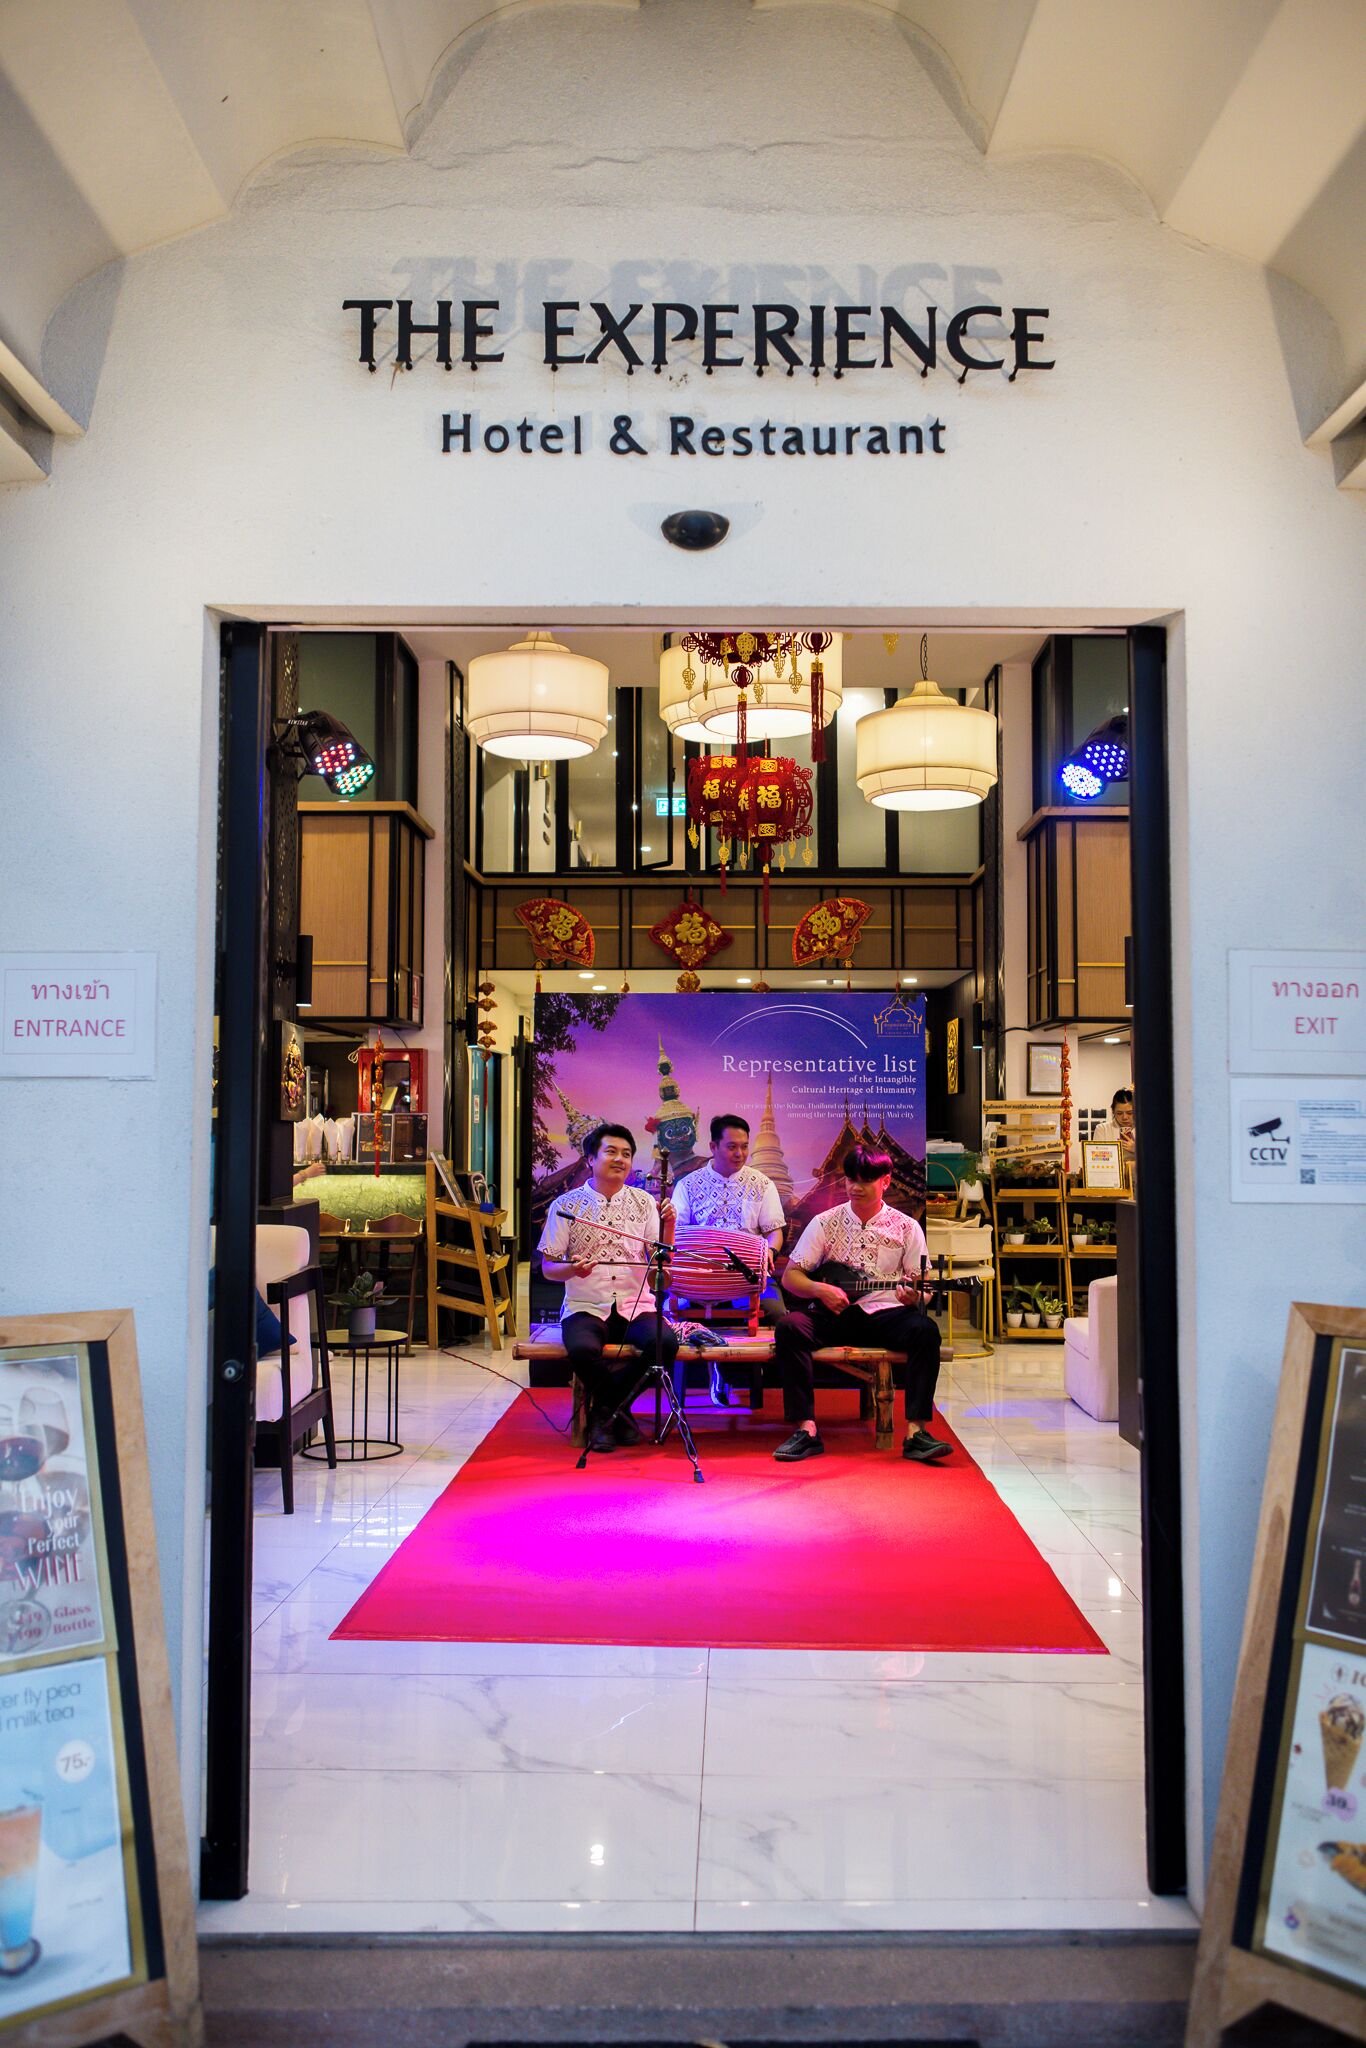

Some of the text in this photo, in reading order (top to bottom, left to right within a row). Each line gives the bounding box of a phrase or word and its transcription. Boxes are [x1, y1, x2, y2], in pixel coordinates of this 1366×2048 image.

[342, 300, 1056, 371] THE EXPERIENCE
[441, 413, 947, 457] Hotel & Restaurant
[31, 979, 110, 1000] ทางเข้า
[1271, 980, 1360, 999] ทางออก
[14, 1018, 126, 1038] ENTRANCE
[1294, 1016, 1339, 1035] EXIT
[722, 1054, 917, 1078] Representative list
[791, 1085, 917, 1095] Cultural Heritage of Humanity
[849, 1074, 917, 1085] of the Intangible
[1250, 1147, 1288, 1161] CCTV
[20, 1486, 78, 1519] Enjoy
[46, 1515, 79, 1537] your
[28, 1533, 80, 1555] Perfect
[14, 1552, 85, 1591] WINE
[54, 1604, 92, 1619] Glass
[53, 1618, 96, 1635] Bottle
[46, 1683, 81, 1705] pea
[6, 1706, 75, 1731] milk tea
